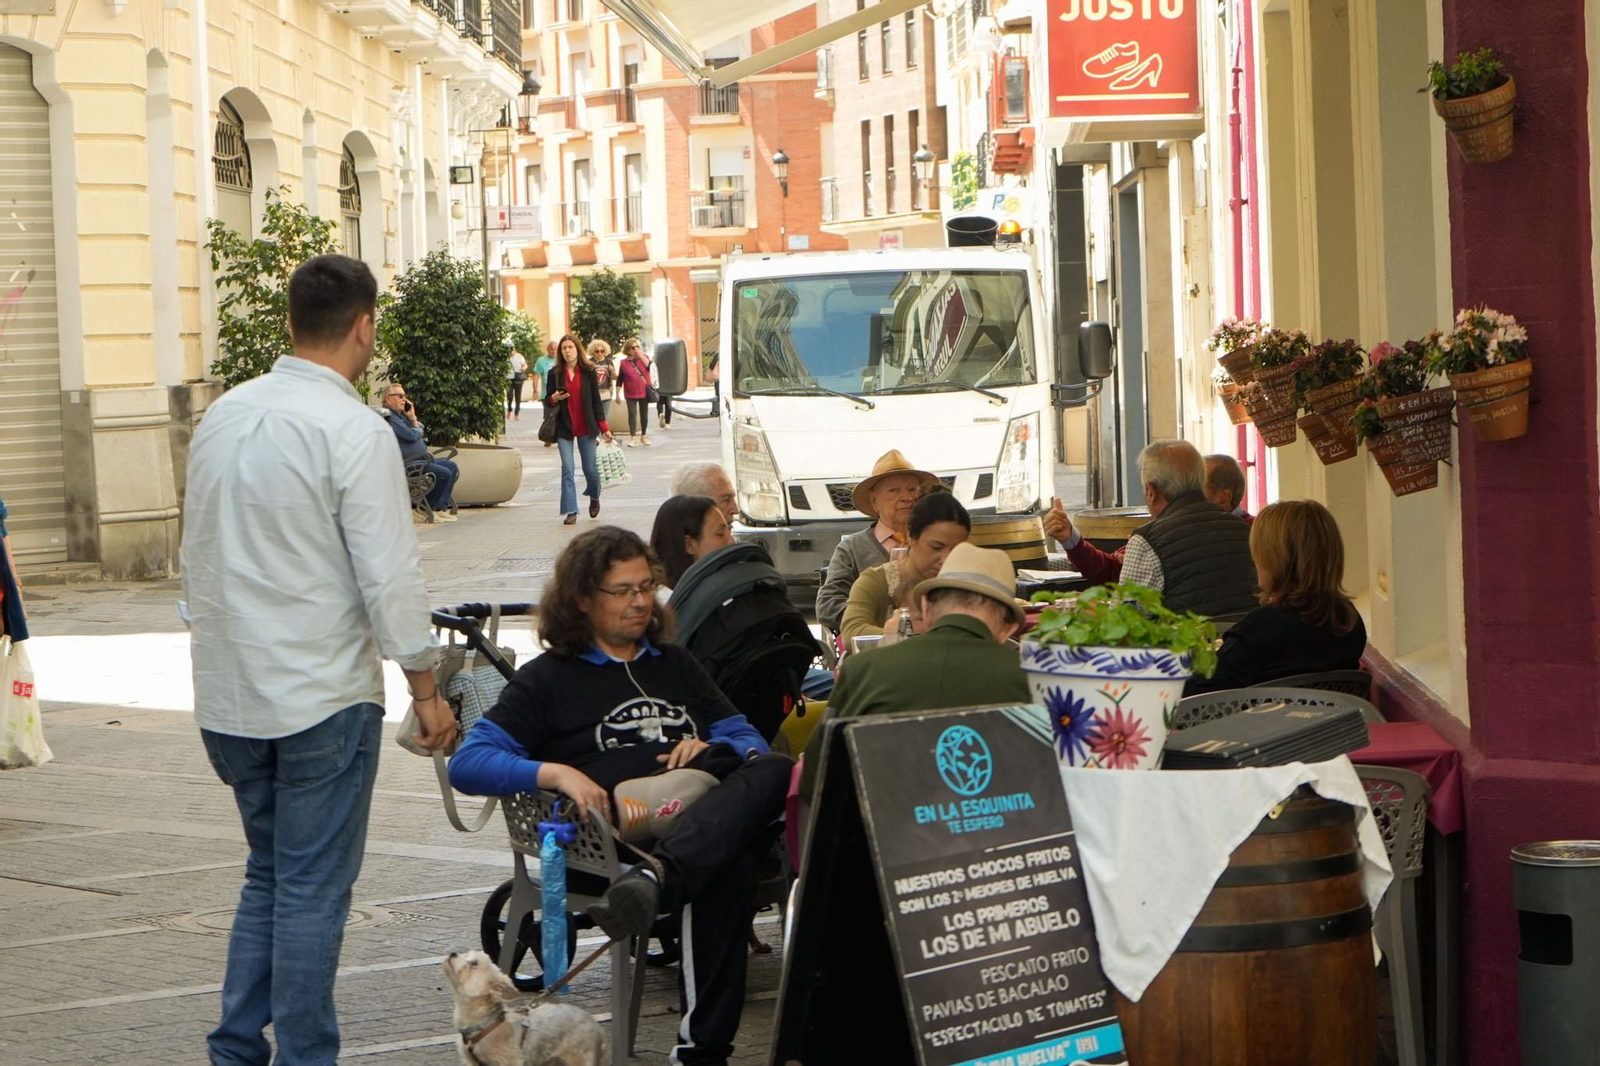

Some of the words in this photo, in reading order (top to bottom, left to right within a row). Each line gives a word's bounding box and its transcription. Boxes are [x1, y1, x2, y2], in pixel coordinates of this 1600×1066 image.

[914, 804, 937, 824] EN
[938, 802, 960, 820] LA
[961, 792, 1035, 818] ESQUINITA
[948, 819, 963, 834] TE
[962, 815, 1005, 833] ESPERO
[894, 867, 966, 895] NUESTROS
[967, 855, 1025, 879] CHOCOS
[1025, 846, 1072, 868] FRITOS
[899, 896, 925, 914] SON
[925, 892, 951, 909] LOS
[964, 879, 1016, 902] MEJORES
[1016, 875, 1033, 890] DE
[1032, 866, 1078, 887] HUELVA
[943, 911, 976, 931] LOS
[976, 895, 1050, 924] PRIMEROS
[920, 934, 960, 959] LOS
[961, 928, 987, 950] DE
[987, 922, 1012, 944] MI
[1015, 908, 1081, 939] ABUELO
[980, 955, 1050, 985] PESCAITO
[1051, 946, 1090, 970] FRITO
[922, 995, 975, 1022] PAVIAS
[975, 990, 998, 1010] DE
[997, 974, 1070, 1005] BACALAO
[1025, 1006, 1046, 1024] DE
